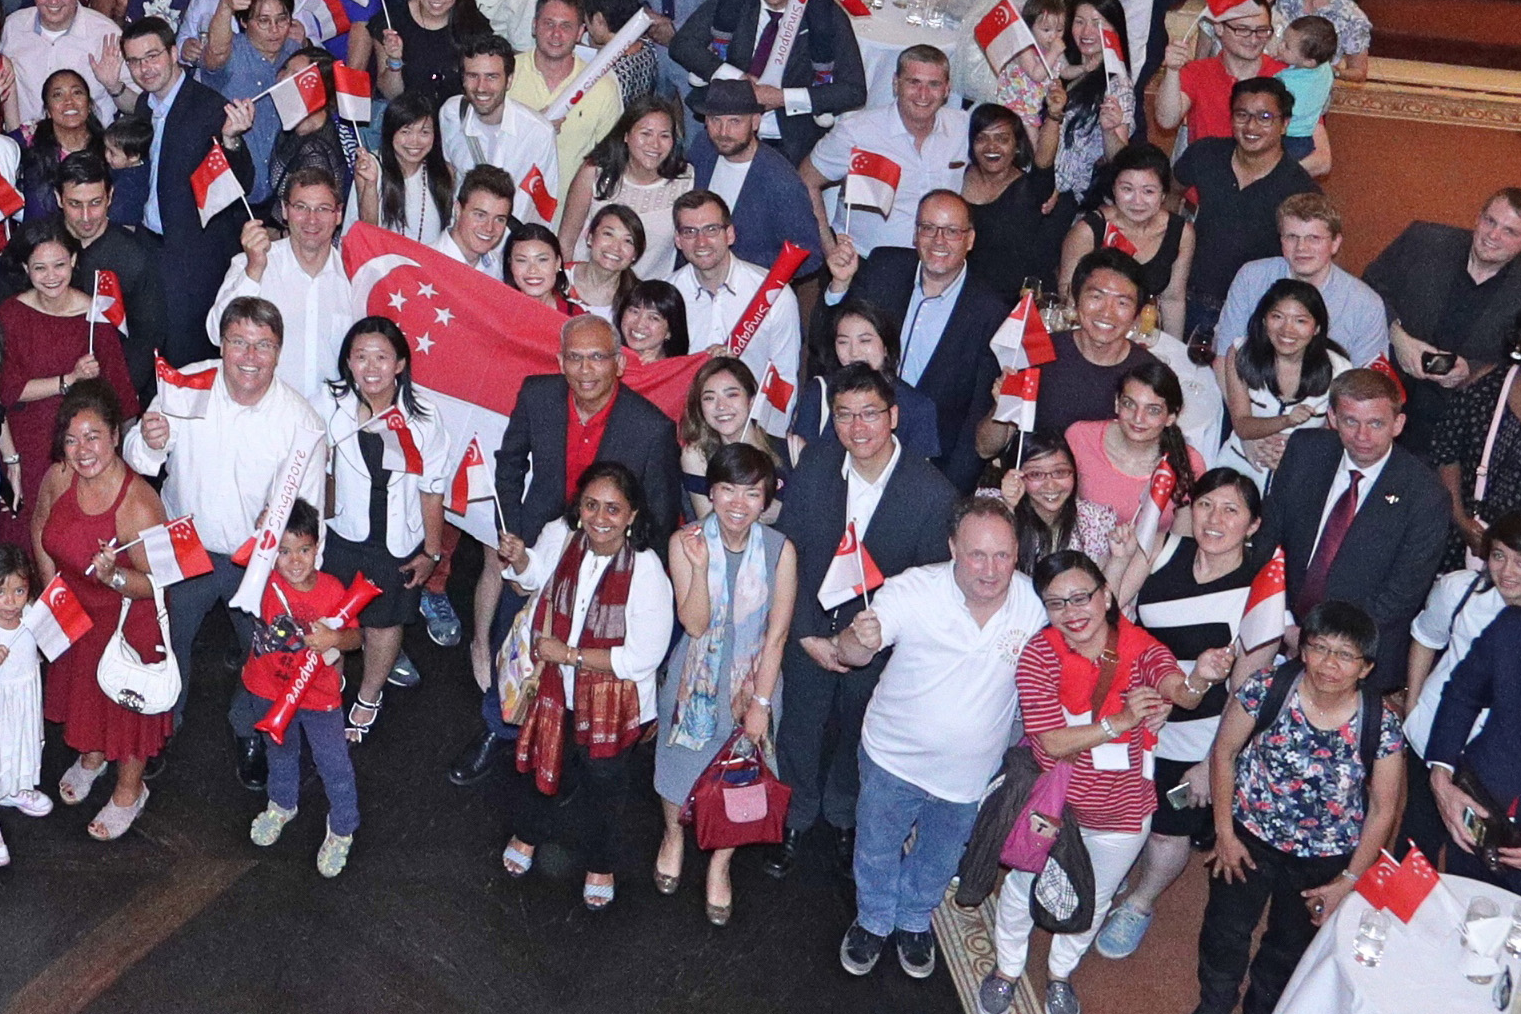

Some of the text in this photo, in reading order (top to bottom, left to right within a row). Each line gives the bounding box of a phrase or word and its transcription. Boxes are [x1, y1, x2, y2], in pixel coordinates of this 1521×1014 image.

[773, 1, 804, 65] Singapore
[583, 40, 632, 90] Singapore
[731, 303, 770, 356] Singapo
[268, 449, 307, 531] Singapore
[285, 649, 319, 704] gapore
